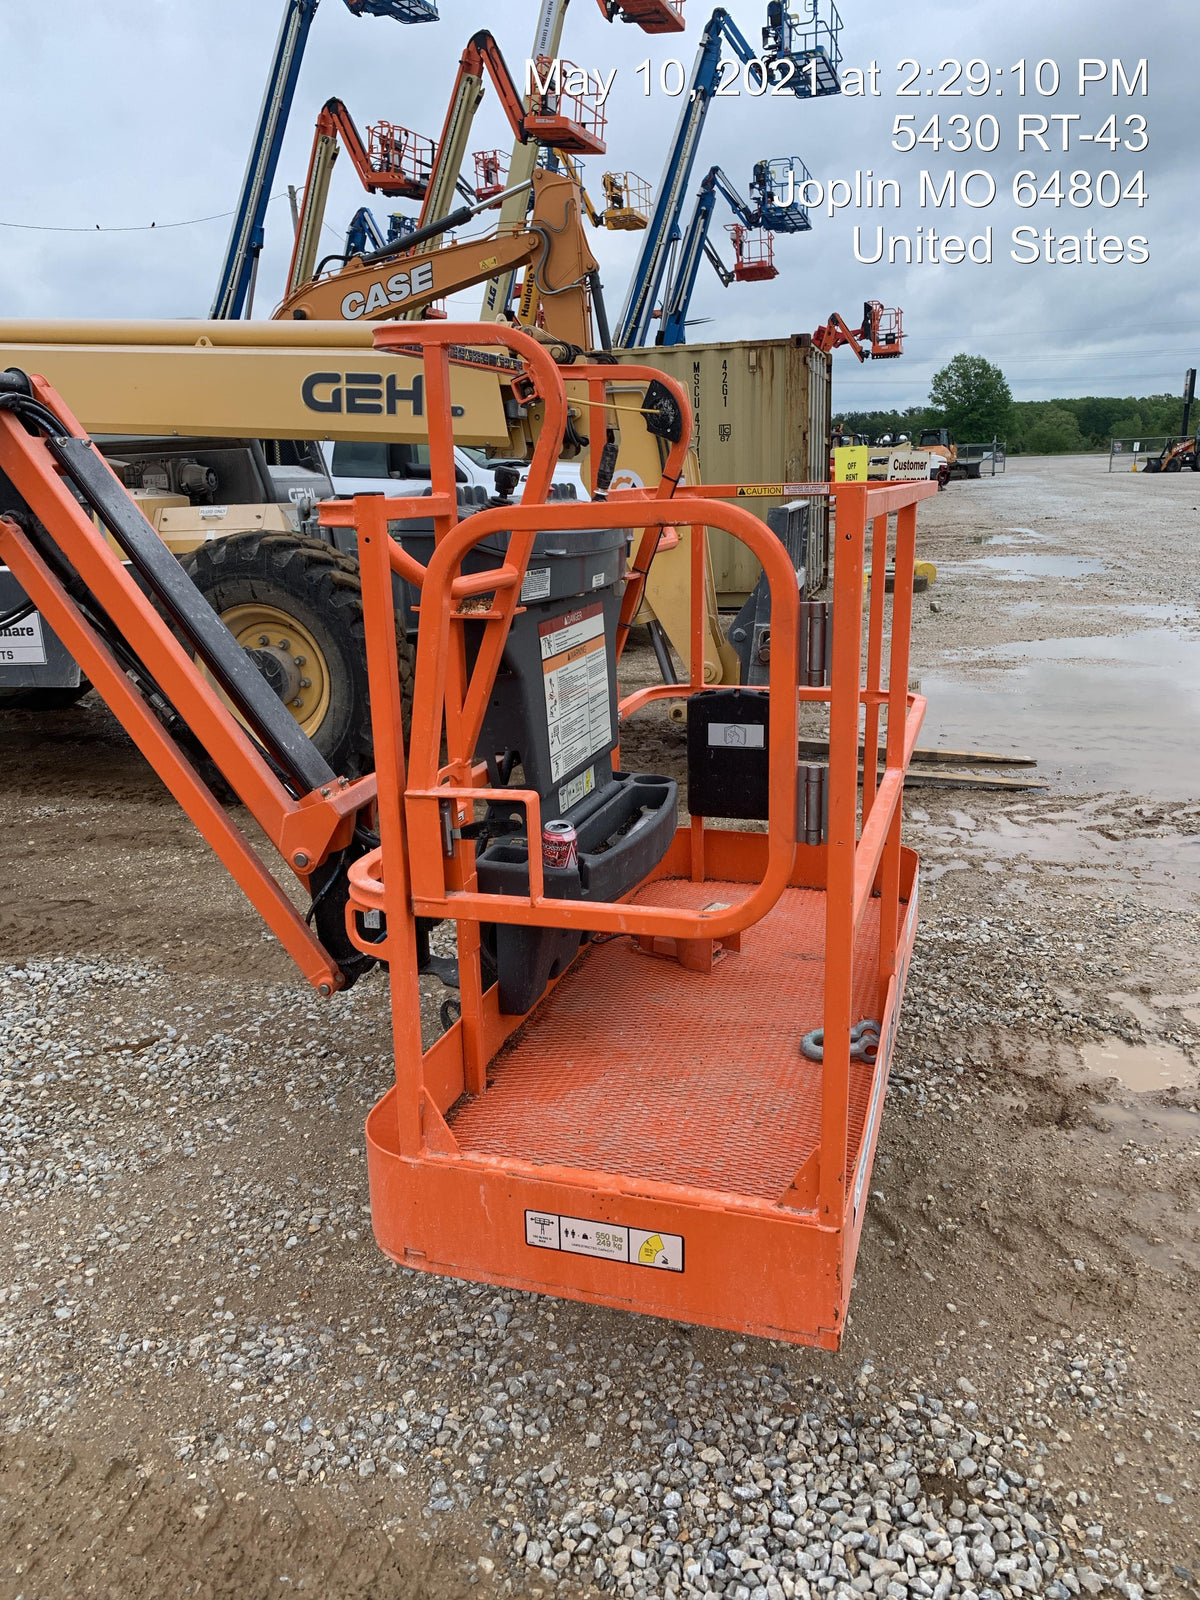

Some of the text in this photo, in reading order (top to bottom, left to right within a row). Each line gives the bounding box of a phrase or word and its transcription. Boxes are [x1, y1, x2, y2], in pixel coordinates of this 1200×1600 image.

[341, 261, 433, 320] CASE
[521, 273, 536, 317] Haulotte
[487, 286, 498, 310] JLG
[302, 372, 465, 417] GEH
[847, 462, 857, 470] OFF
[893, 459, 928, 471] Customer
[845, 473, 858, 481] RENT
[746, 487, 781, 495] CAUTION
[567, 611, 582, 625] DANGER
[595, 1231, 624, 1243] 550 lbs
[596, 1239, 623, 1251] 249 kg
